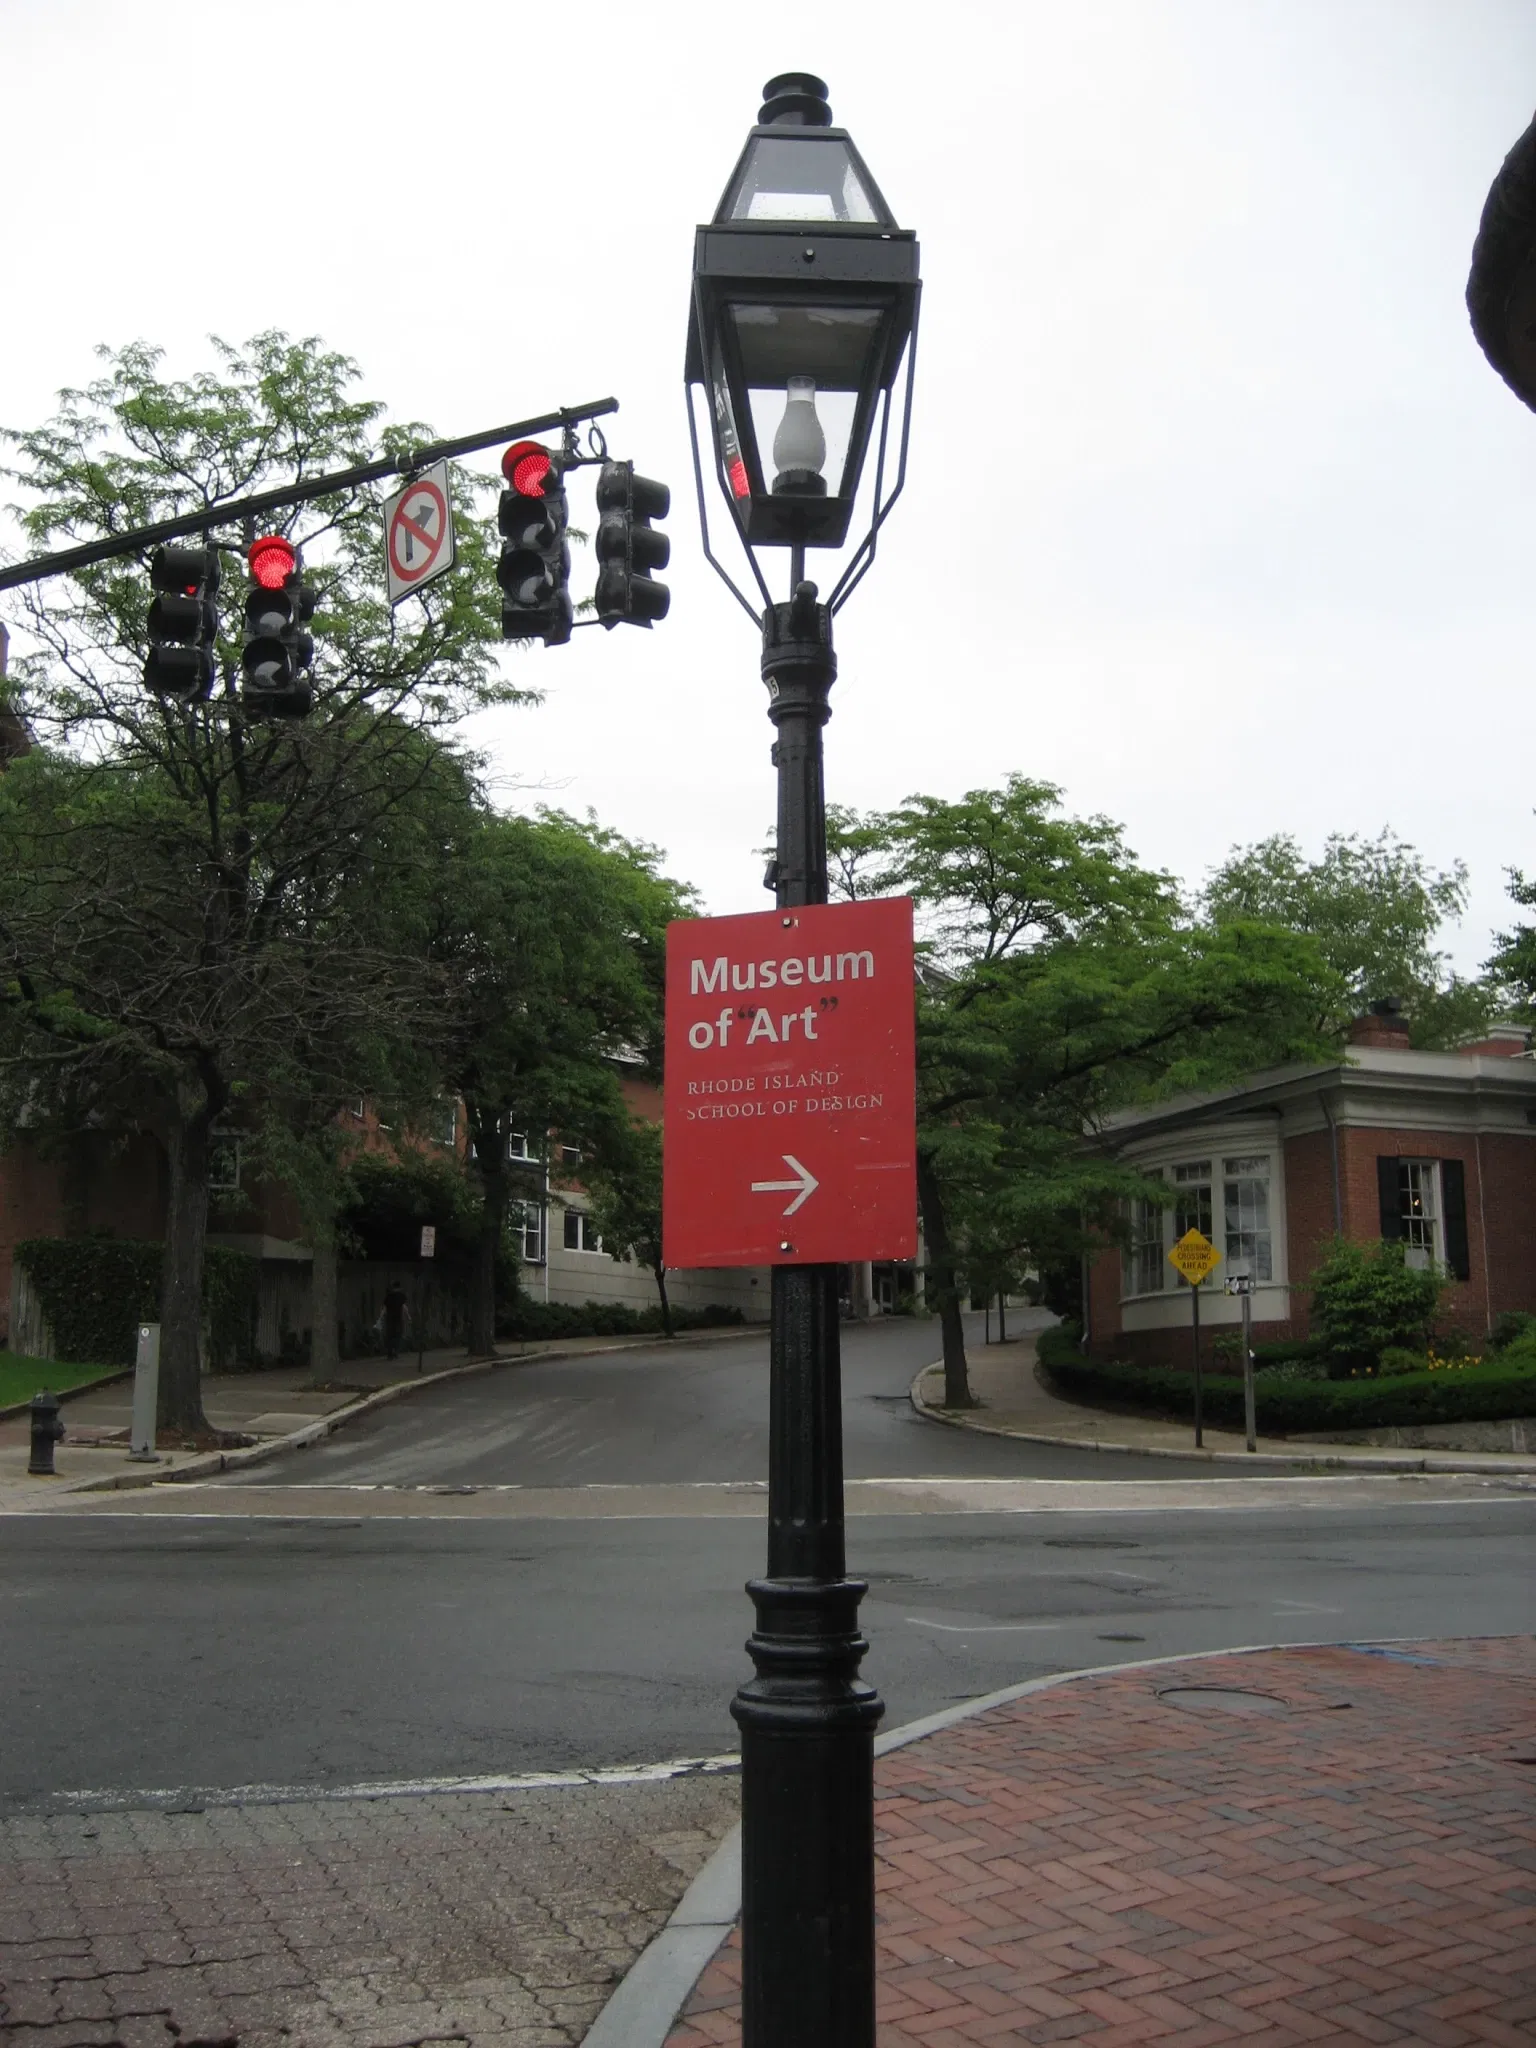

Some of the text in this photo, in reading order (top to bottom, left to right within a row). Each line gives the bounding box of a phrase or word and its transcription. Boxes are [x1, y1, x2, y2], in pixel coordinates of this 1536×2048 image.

[691, 950, 874, 995] Museum
[688, 1007, 733, 1049] of
[687, 1071, 840, 1095] RHODE ISLAND
[686, 1093, 884, 1121] SCHOOL OF DESIGN
[1178, 1252, 1211, 1260] CROSSING
[1182, 1262, 1207, 1270] AHEAD
